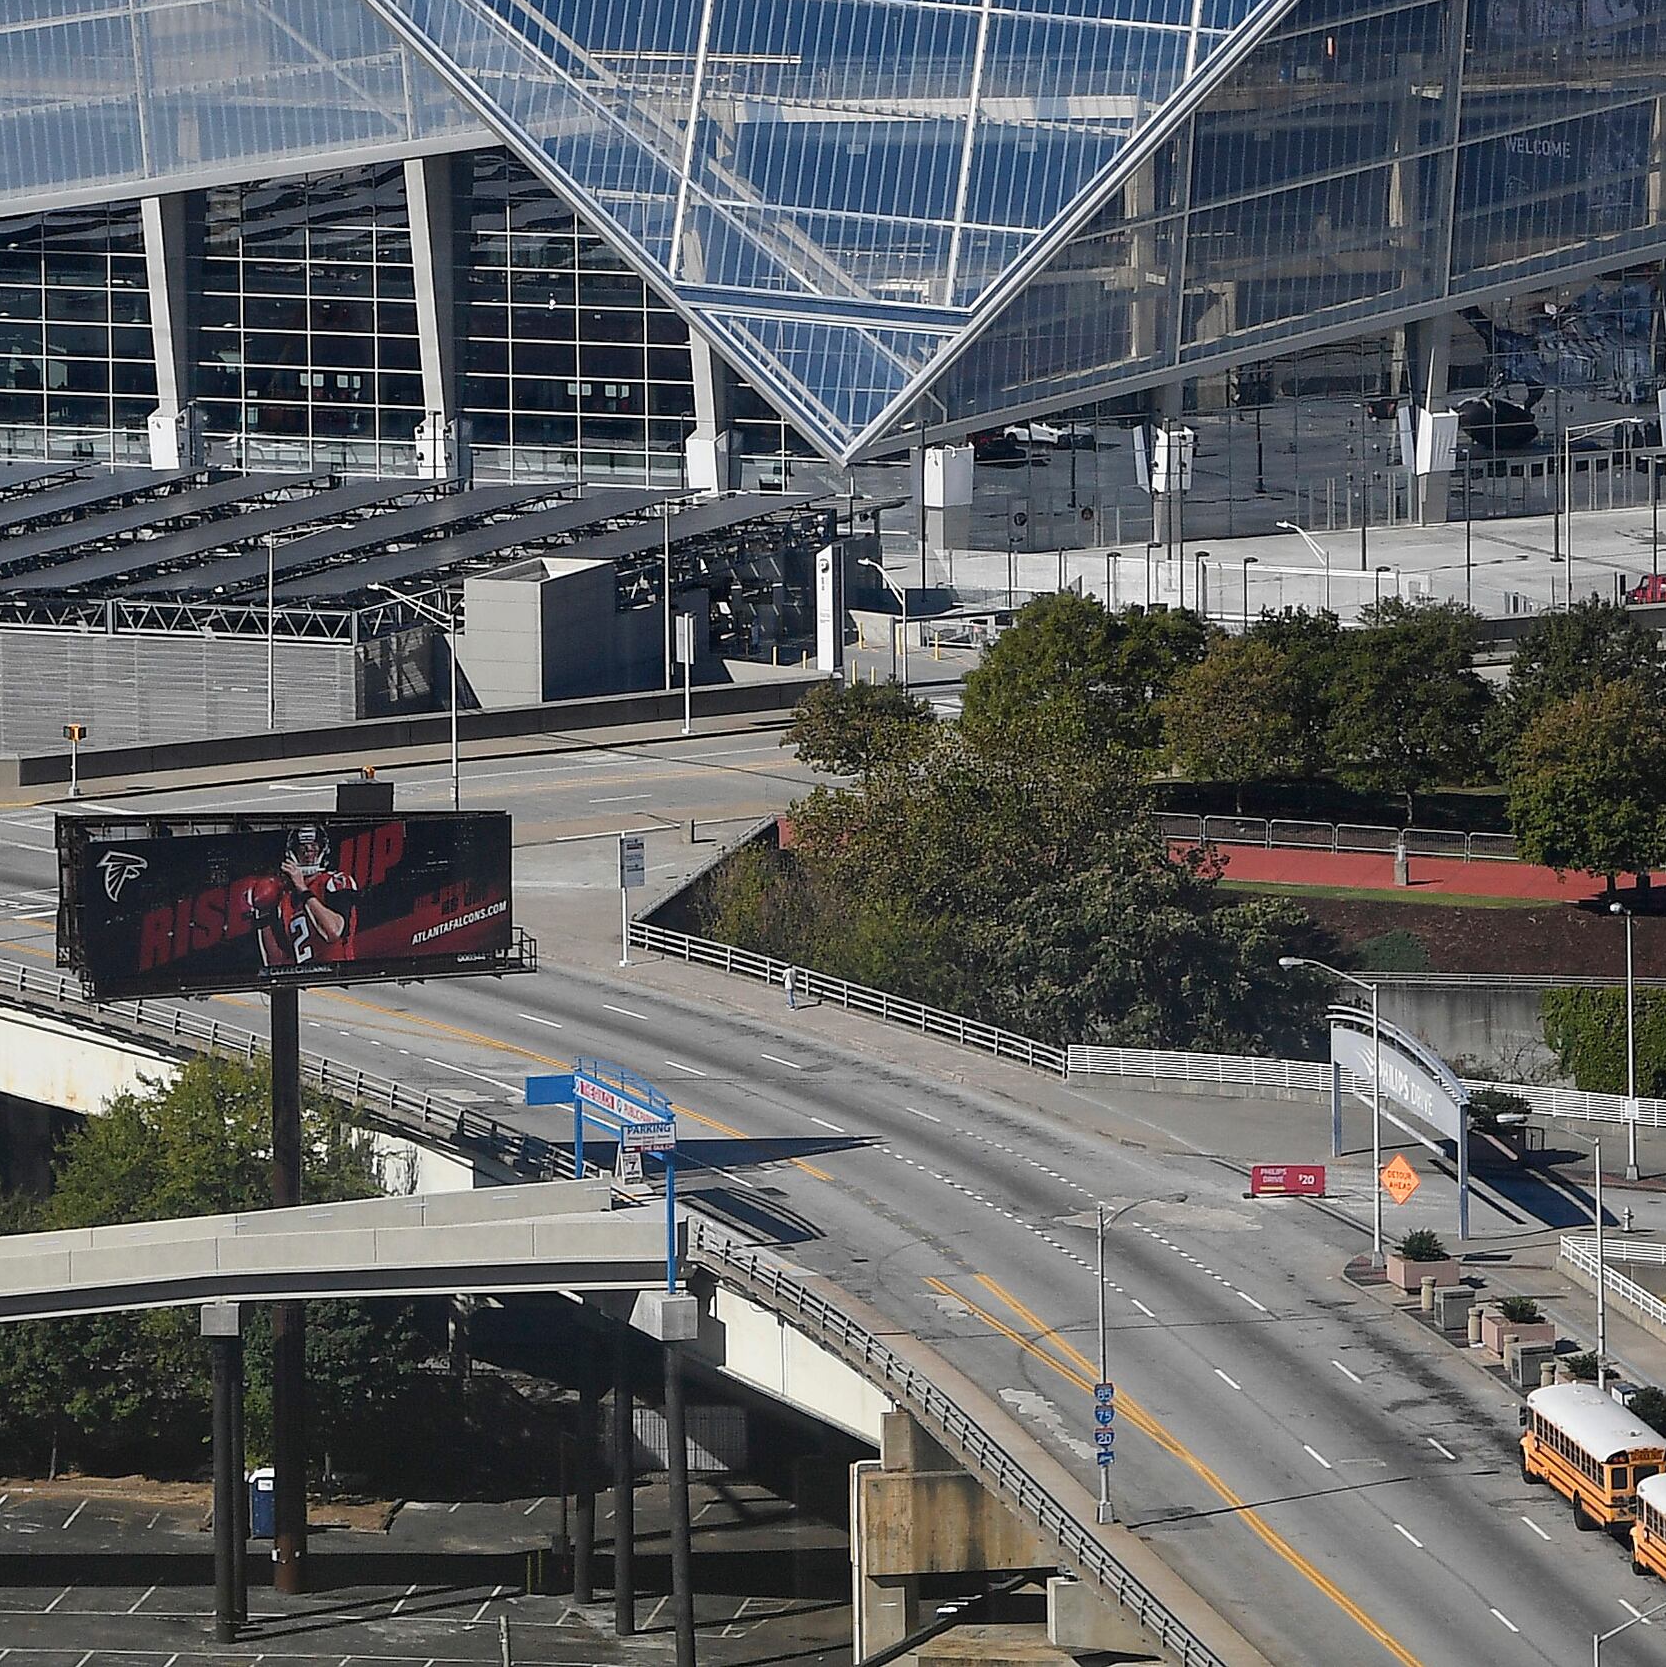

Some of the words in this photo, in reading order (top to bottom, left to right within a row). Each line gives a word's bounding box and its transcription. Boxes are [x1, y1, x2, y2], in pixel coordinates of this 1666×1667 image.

[1504, 137, 1571, 158] WELCOME
[139, 876, 253, 973] RISE
[412, 900, 507, 945] ATLANTAFALCONS.COM
[290, 913, 312, 964] 2
[627, 1123, 671, 1134] PARKING
[1298, 1174, 1315, 1184] $20
[1387, 1170, 1412, 1179] DETOUR
[1389, 1181, 1412, 1191] AHEAD
[1097, 1388, 1112, 1400] 85
[1097, 1411, 1112, 1422] 75
[1097, 1434, 1112, 1444] 20
